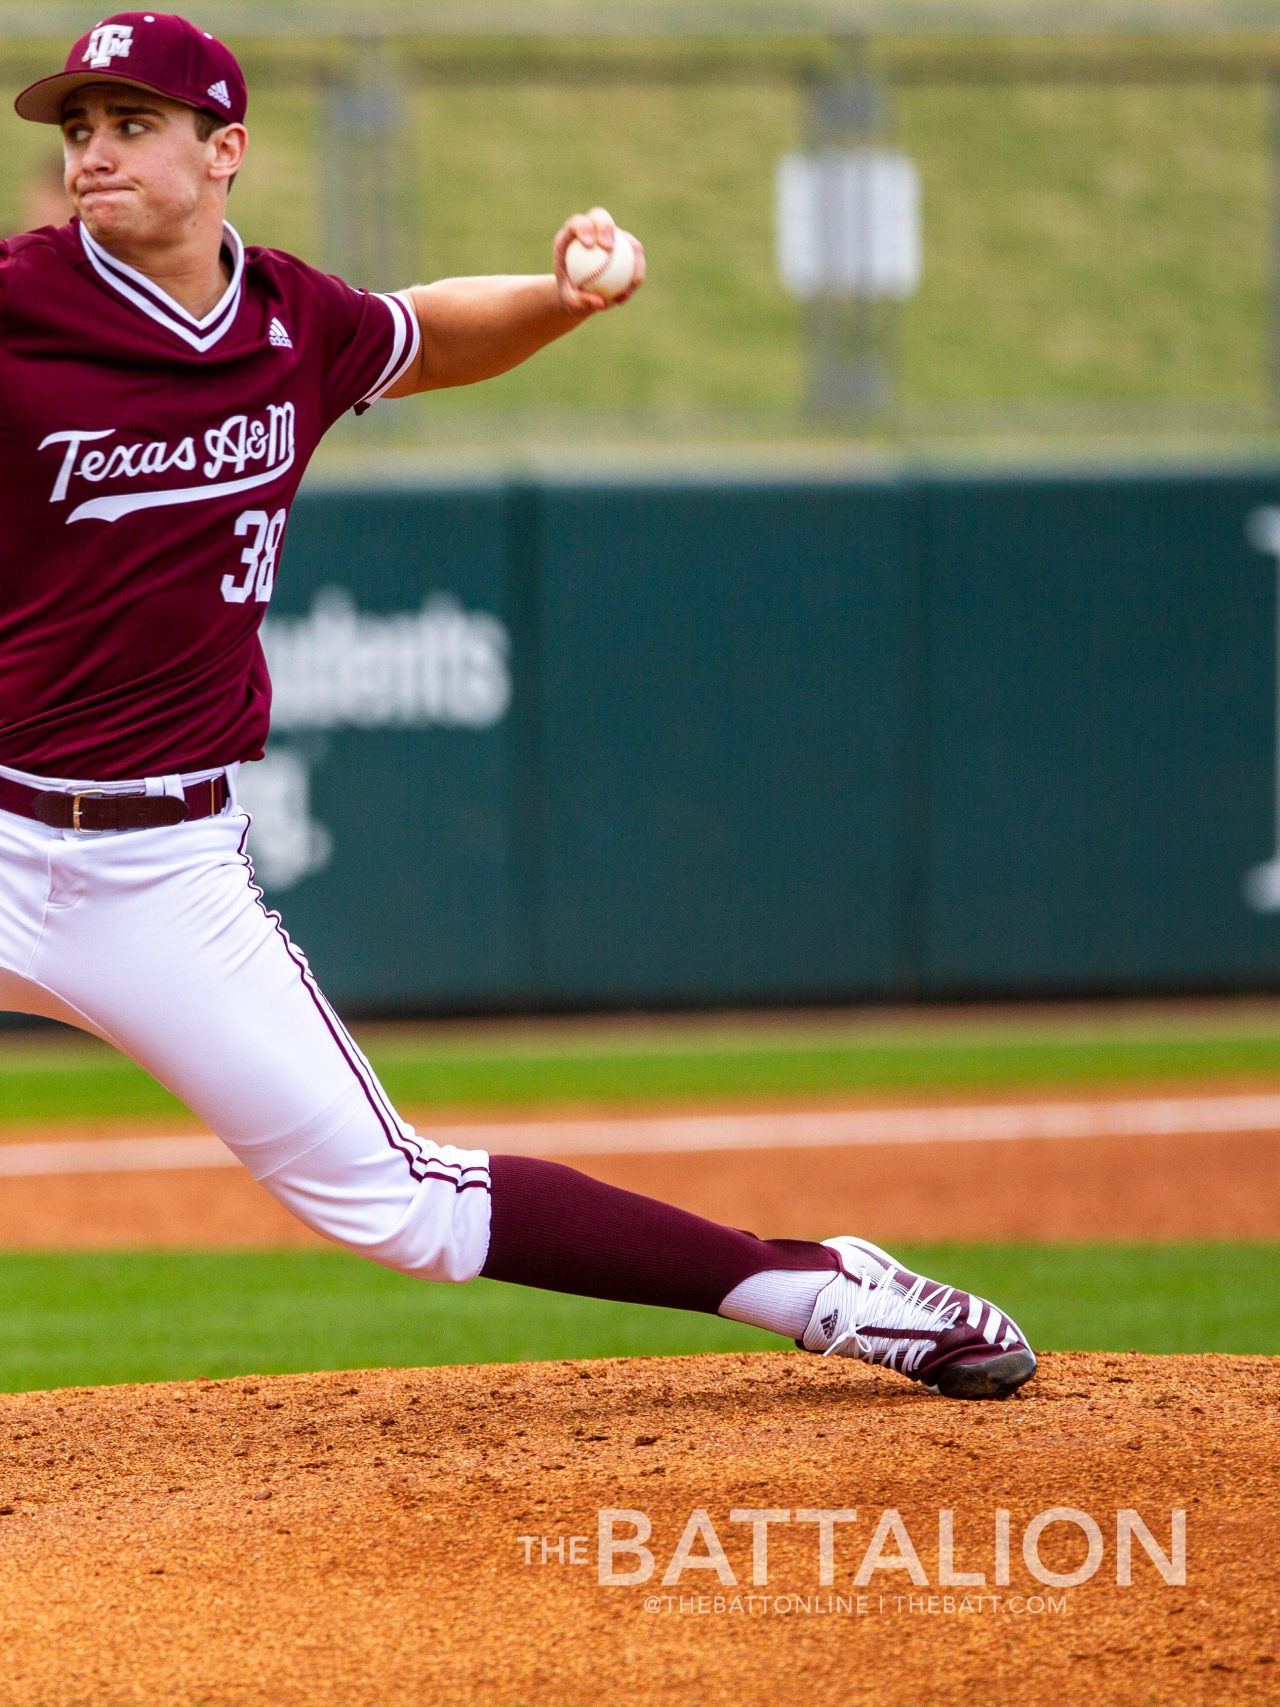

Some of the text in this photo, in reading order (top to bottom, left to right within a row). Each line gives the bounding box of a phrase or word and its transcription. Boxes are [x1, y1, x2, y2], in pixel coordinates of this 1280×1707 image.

[38, 401, 295, 502] Texas A&M
[221, 508, 286, 603] 38
[261, 576, 513, 732] udents
